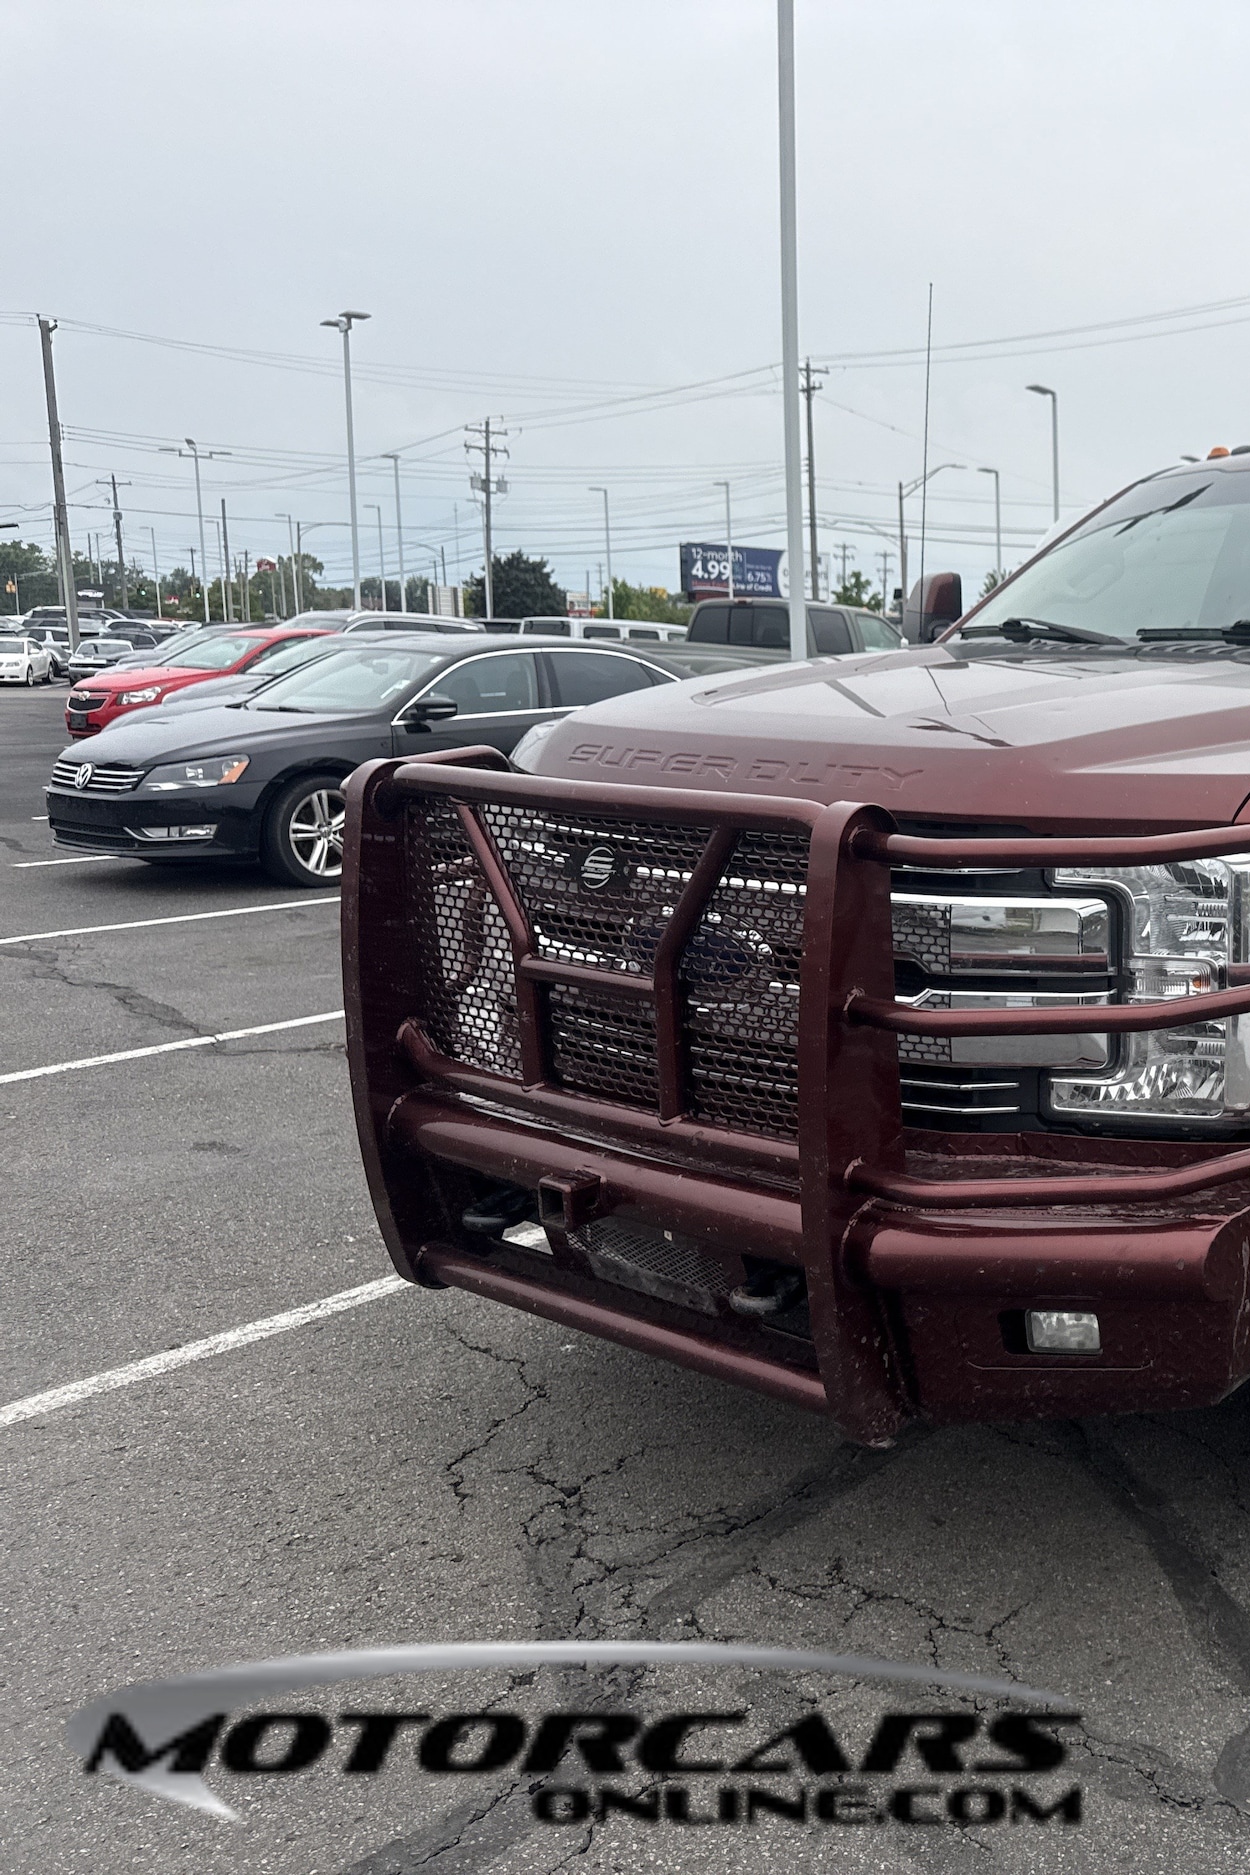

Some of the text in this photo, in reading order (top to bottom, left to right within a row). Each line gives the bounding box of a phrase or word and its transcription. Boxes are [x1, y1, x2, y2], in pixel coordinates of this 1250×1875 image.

[691, 561, 730, 580] 4.99
[568, 743, 924, 792] SUPER DUTY
